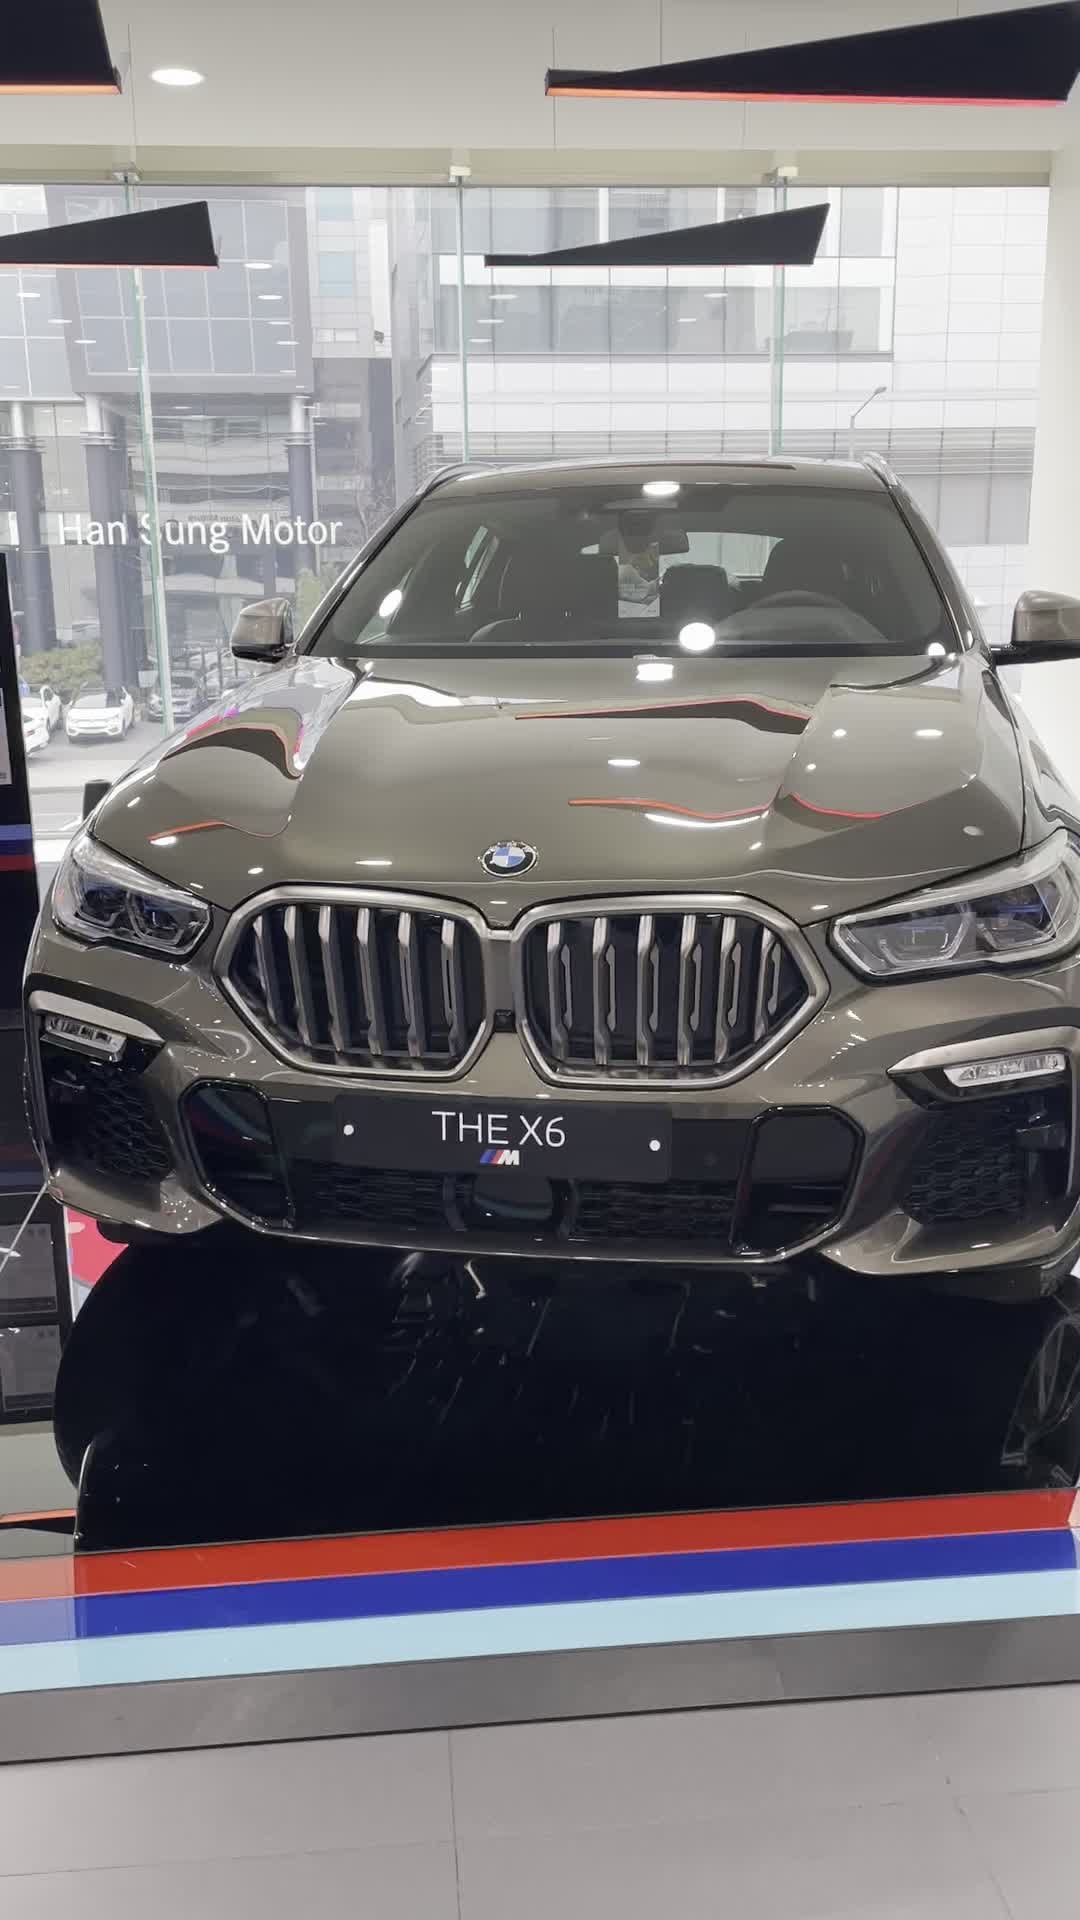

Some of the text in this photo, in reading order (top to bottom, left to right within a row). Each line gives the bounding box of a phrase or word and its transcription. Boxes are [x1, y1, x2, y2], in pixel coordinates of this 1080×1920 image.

[58, 513, 127, 545] Han
[241, 512, 343, 545] Motor
[431, 1110, 566, 1148] THE X6
[495, 1149, 520, 1166] M
